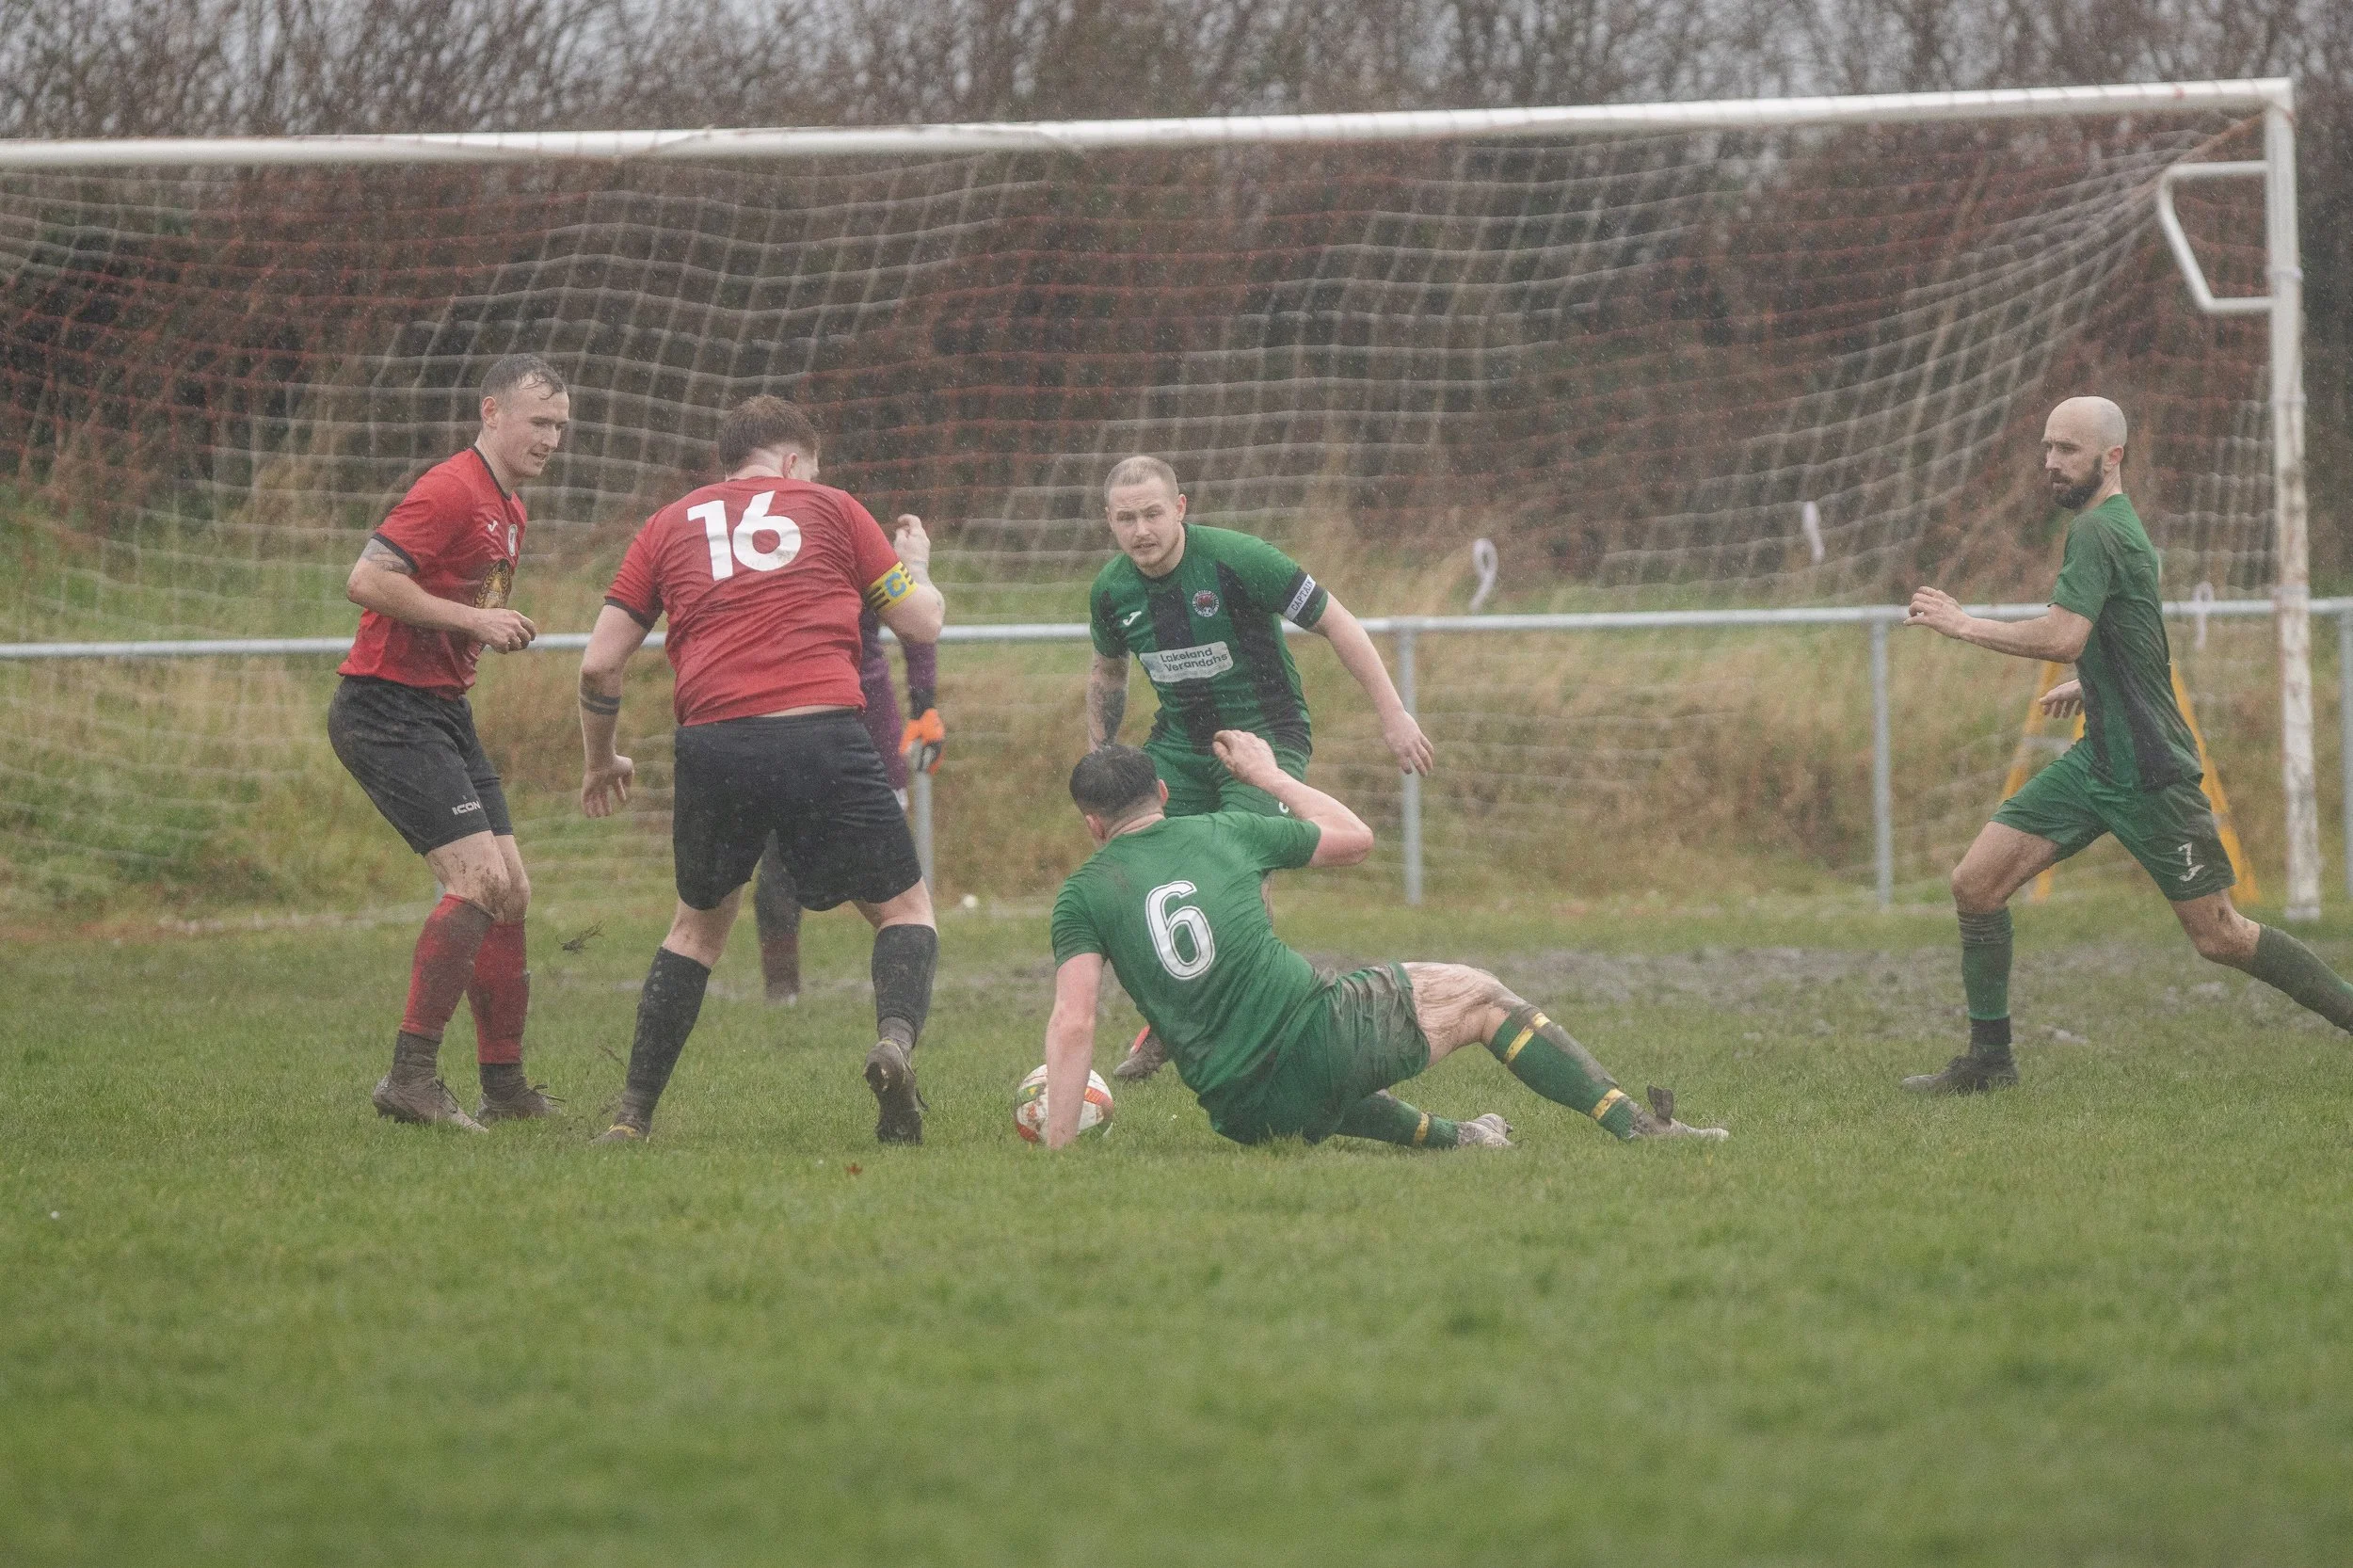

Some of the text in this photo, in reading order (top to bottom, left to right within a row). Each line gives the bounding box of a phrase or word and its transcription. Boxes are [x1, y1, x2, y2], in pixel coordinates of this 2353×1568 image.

[687, 490, 802, 582] 16
[885, 572, 906, 598] C
[1290, 578, 1314, 612] CAPTAIN
[1160, 648, 1214, 663] Lakeland
[1164, 653, 1228, 672] Verandahs
[452, 800, 481, 816] ICON
[2178, 842, 2193, 866] 7
[1145, 880, 1215, 980] 6
